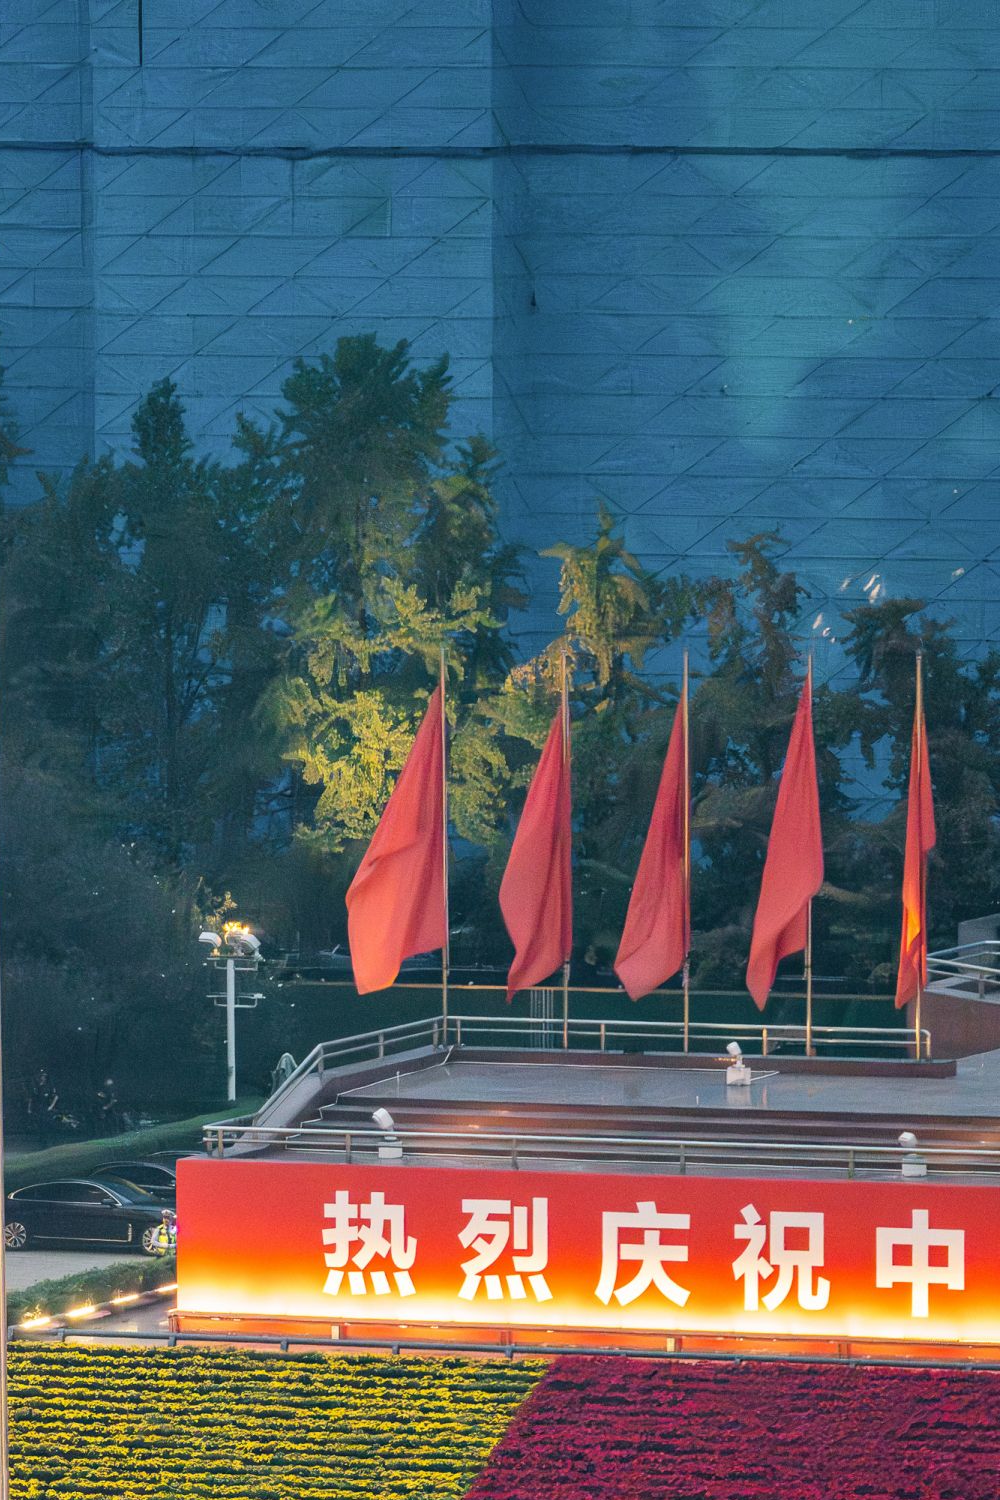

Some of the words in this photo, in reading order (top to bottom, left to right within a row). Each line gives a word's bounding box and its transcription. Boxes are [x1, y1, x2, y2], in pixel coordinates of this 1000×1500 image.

[321, 1190, 965, 1318] 热烈庆祝中
